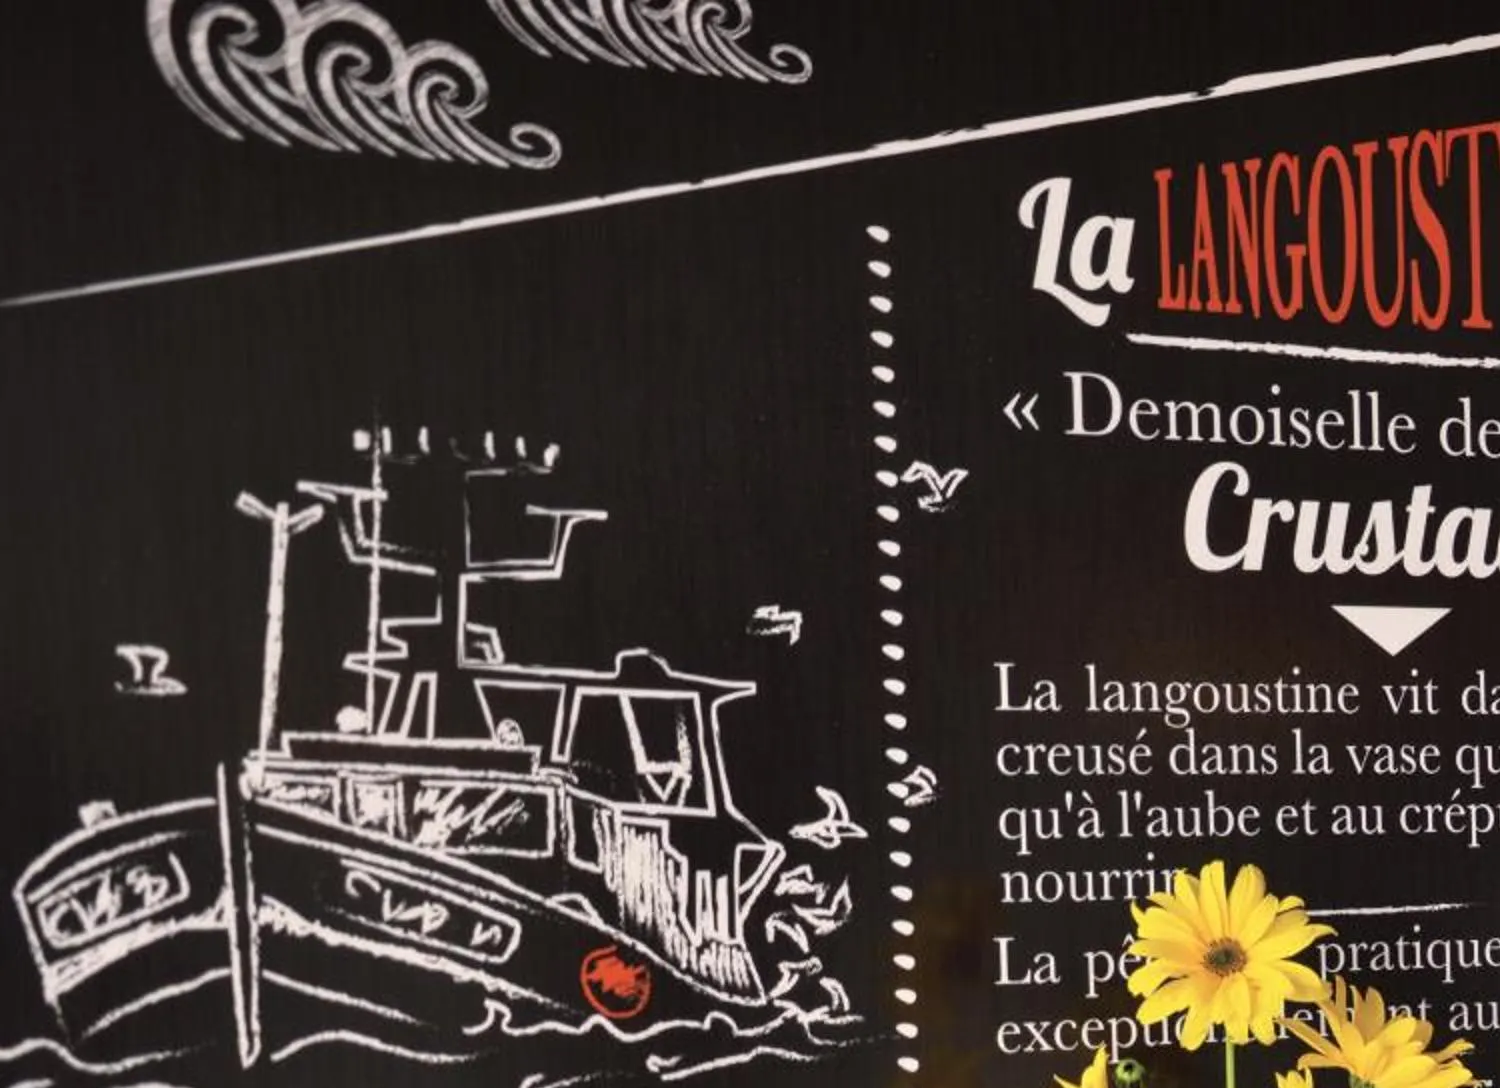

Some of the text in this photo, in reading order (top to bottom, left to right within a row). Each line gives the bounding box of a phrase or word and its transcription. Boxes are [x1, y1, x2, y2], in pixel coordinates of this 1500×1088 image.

[1019, 177, 1135, 327] La
[1064, 372, 1415, 453] Demoiselle
[994, 663, 1061, 711] La
[1086, 664, 1359, 728] langoustine
[1382, 669, 1438, 714] vit
[997, 728, 1152, 776] creusé
[1169, 728, 1278, 775] dans
[1292, 728, 1333, 774] la
[1346, 744, 1440, 774] vase
[999, 791, 1104, 855] qu'à
[1118, 790, 1260, 837] l'aube
[1276, 801, 1317, 836] et
[1332, 805, 1385, 834] au
[994, 937, 1060, 985] La
[1450, 1002, 1500, 1031] au
